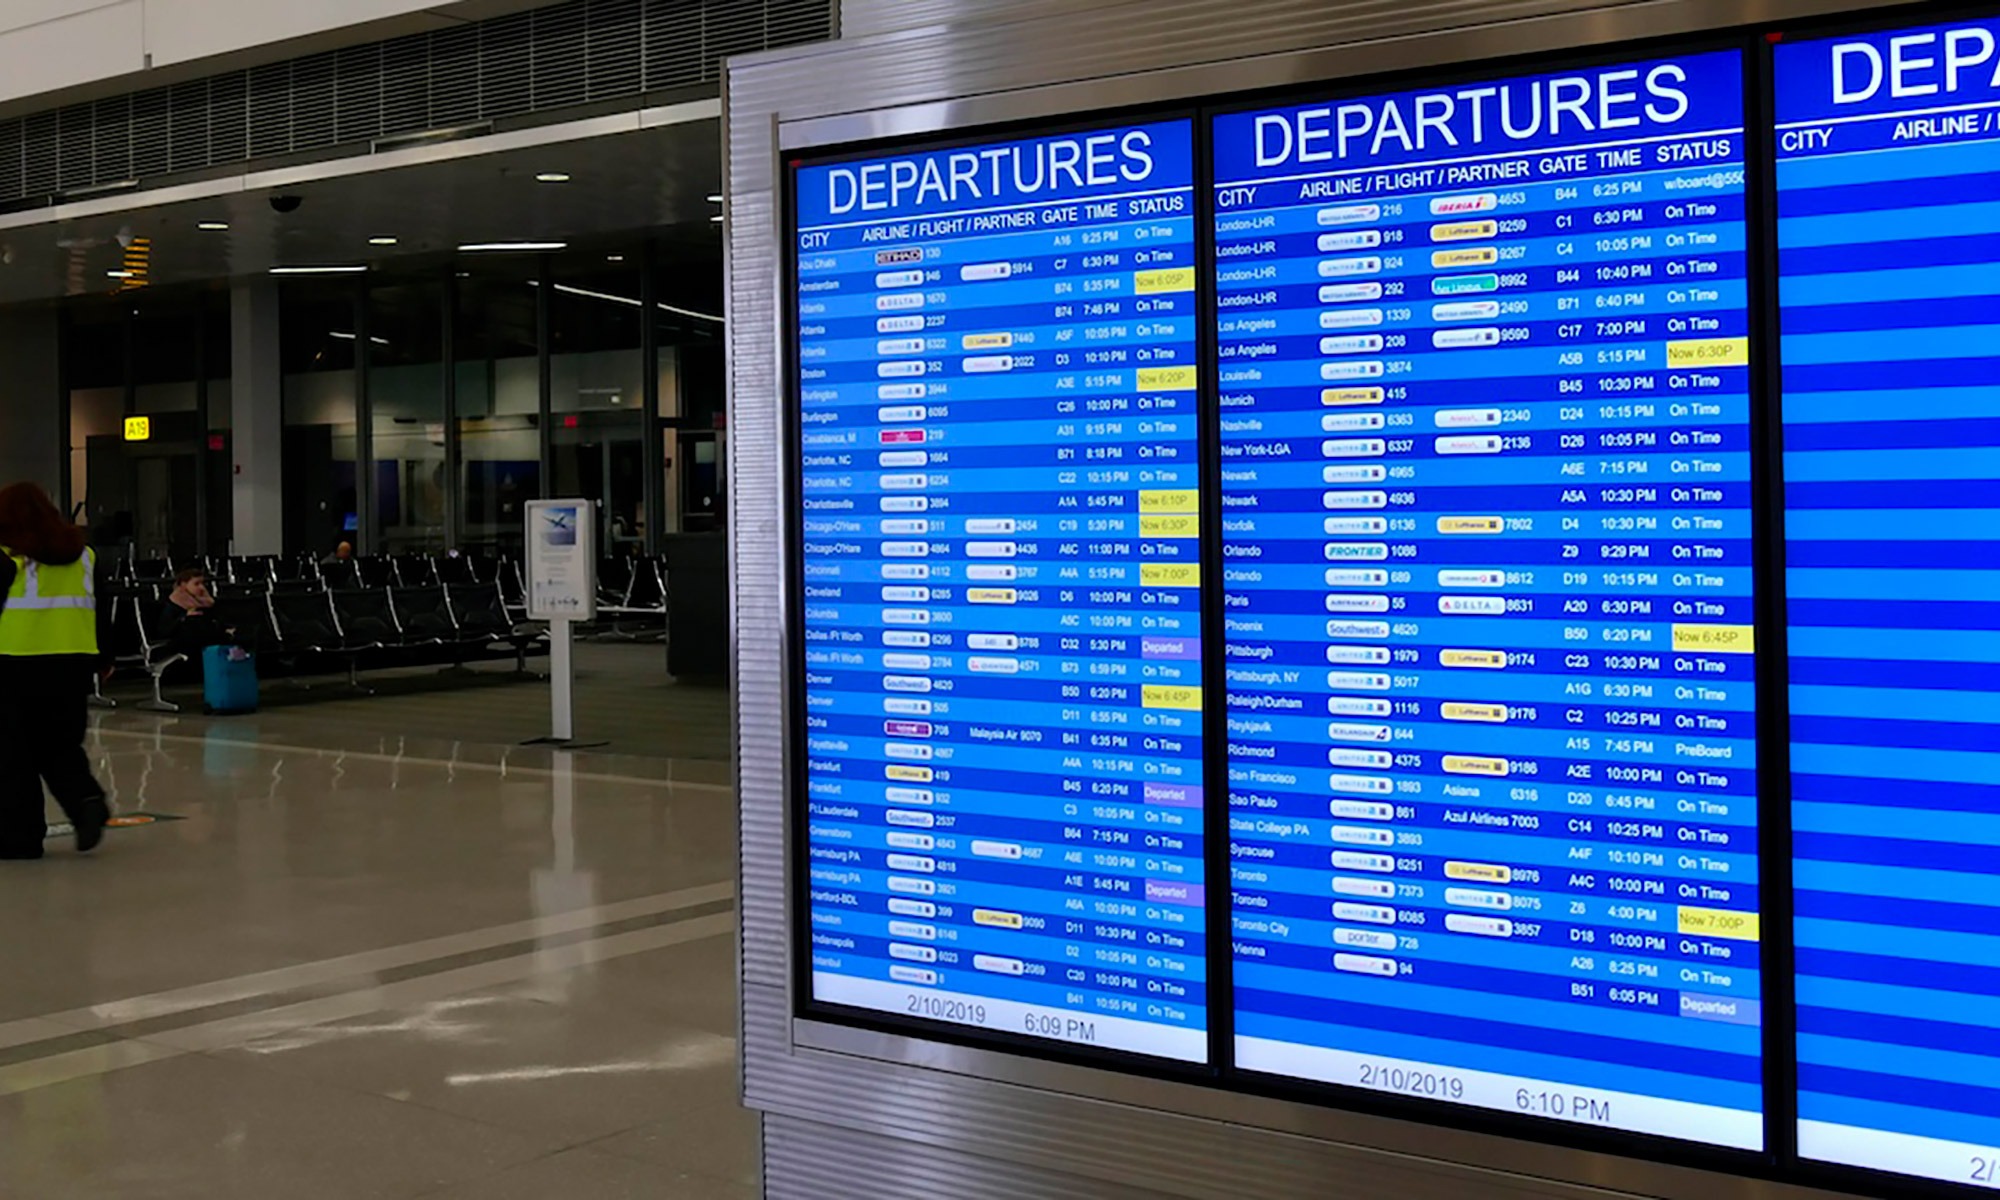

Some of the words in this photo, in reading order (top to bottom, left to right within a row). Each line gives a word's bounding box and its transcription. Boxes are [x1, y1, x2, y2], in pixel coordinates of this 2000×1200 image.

[1832, 28, 2000, 104] DEP
[1256, 65, 1686, 165] DEPARTURES
[1781, 128, 1833, 151] CITY
[1892, 114, 1979, 140] AIRLINE
[829, 132, 1151, 212] DEPARTURES
[1218, 187, 1256, 206] CITY
[1300, 177, 1361, 197] AIRLINE
[1365, 177, 1371, 191] /
[1375, 169, 1434, 190] FLIGHT
[1437, 169, 1444, 184] /
[1447, 160, 1529, 182] PARTNER
[1539, 154, 1587, 173] GATE
[1596, 148, 1640, 167] TIME
[1657, 139, 1730, 162] STATUS
[800, 231, 828, 248] CITY
[862, 224, 909, 241] AIRLINE
[919, 218, 964, 235] FLIGHT
[973, 211, 1035, 229] PARTNER
[1042, 206, 1077, 223] GATE
[1085, 202, 1117, 218] TIME
[1129, 195, 1183, 214] STATUS
[1215, 215, 1274, 231] London-LHR
[1382, 203, 1402, 216] 216
[1437, 202, 1472, 211] IBERIA
[1498, 191, 1525, 204] 4653
[1555, 187, 1577, 200] B44
[1593, 182, 1618, 196] 6:25
[1621, 181, 1641, 193] PM
[1216, 240, 1275, 256] London-LHR
[1383, 229, 1403, 242] 918
[1498, 218, 1526, 232] 9259
[1556, 215, 1571, 228] C1
[1593, 210, 1619, 224] 6:30
[1622, 208, 1642, 221] PM
[1664, 205, 1683, 218] On
[1686, 203, 1716, 215] Time
[1054, 258, 1066, 269] C7
[1103, 254, 1118, 265] PM
[1134, 252, 1149, 263] On
[1151, 250, 1173, 260] Time
[1218, 346, 1234, 356] Los
[1233, 343, 1276, 357] Angeles
[1385, 334, 1405, 347] 208
[1501, 327, 1529, 341] 9590
[1558, 324, 1581, 337] C17
[1596, 322, 1621, 334] 7:00
[1624, 320, 1644, 333] PM
[1667, 318, 1685, 331] On
[1689, 317, 1718, 329] Time
[127, 420, 147, 436] A19
[1220, 445, 1242, 456] New
[1244, 443, 1290, 455] York-LGA
[1387, 439, 1413, 451] 6337
[1503, 436, 1530, 449] 2136
[1560, 434, 1584, 447] D26
[1599, 433, 1632, 446] 10:05
[1635, 432, 1655, 444] PM
[1670, 431, 1688, 444] On
[1691, 431, 1720, 443] Time
[1114, 543, 1129, 554] PM
[1140, 543, 1154, 554] On
[1156, 543, 1178, 554] Time
[1223, 544, 1261, 556] Orlando
[1328, 546, 1382, 556] FRONTIER
[1391, 544, 1416, 556] 1086
[1562, 544, 1578, 557] Z9
[1600, 545, 1626, 557] 9:29
[1628, 545, 1649, 556] PM
[1672, 545, 1690, 557] On
[1693, 545, 1723, 558] Time
[1224, 594, 1248, 606] Paris
[1392, 597, 1405, 609] 55
[1454, 600, 1491, 609] DELTA
[1506, 598, 1532, 611] 8631
[1563, 600, 1587, 612] A20
[1601, 600, 1627, 613] 6:30
[1630, 600, 1650, 612] PM
[1673, 601, 1691, 614] On
[1695, 601, 1724, 615] Time
[1224, 619, 1262, 630] Phoenix
[1329, 623, 1382, 634] Southwest
[1392, 623, 1418, 635] 4620
[1564, 627, 1588, 639] B50
[1602, 628, 1627, 641] 6:20
[1631, 629, 1651, 640] PM
[1674, 630, 1699, 641] Now
[1702, 631, 1738, 643] 6:45P
[969, 728, 1007, 739] Malaysia
[1007, 729, 1017, 739] Air
[1020, 730, 1041, 741] 9070
[1062, 732, 1079, 743] B41
[1112, 735, 1127, 746] PM
[1143, 737, 1157, 749] On
[1159, 738, 1181, 751] Time
[1394, 728, 1413, 738] 644
[1566, 737, 1589, 749] A15
[1606, 739, 1629, 752] 7:45
[1633, 740, 1652, 752] PM
[1675, 743, 1731, 757] PreBoard
[1229, 793, 1247, 805] Sao
[1250, 794, 1277, 807] Paulo
[1395, 805, 1414, 818] 861
[1443, 810, 1466, 822] Azul
[1469, 812, 1508, 825] Airlines
[1511, 814, 1538, 828] 7003
[1568, 819, 1591, 831] C14
[1607, 822, 1639, 836] 10:25
[1642, 824, 1662, 837] PM
[1677, 827, 1696, 840] On
[1698, 828, 1728, 843] Time
[1065, 921, 1082, 932] D11
[1120, 928, 1135, 939] PM
[1146, 931, 1160, 943] On
[1162, 933, 1184, 946] Time
[1232, 917, 1269, 932] Toronto
[1269, 921, 1288, 936] City
[1347, 929, 1378, 943] porter
[1399, 936, 1418, 949] 728
[1571, 956, 1593, 969] A26
[1609, 960, 1634, 974] 8:25
[1637, 963, 1657, 976] PM
[1680, 968, 1698, 981] On
[1702, 971, 1731, 986] Time
[907, 993, 986, 1024] 2/10/2019
[1024, 1011, 1061, 1035] 6:09
[1066, 1019, 1094, 1040] PM
[1359, 1064, 1462, 1098] 2/10/2019
[1516, 1088, 1564, 1114] 6:10
[1573, 1096, 1609, 1121] PM
